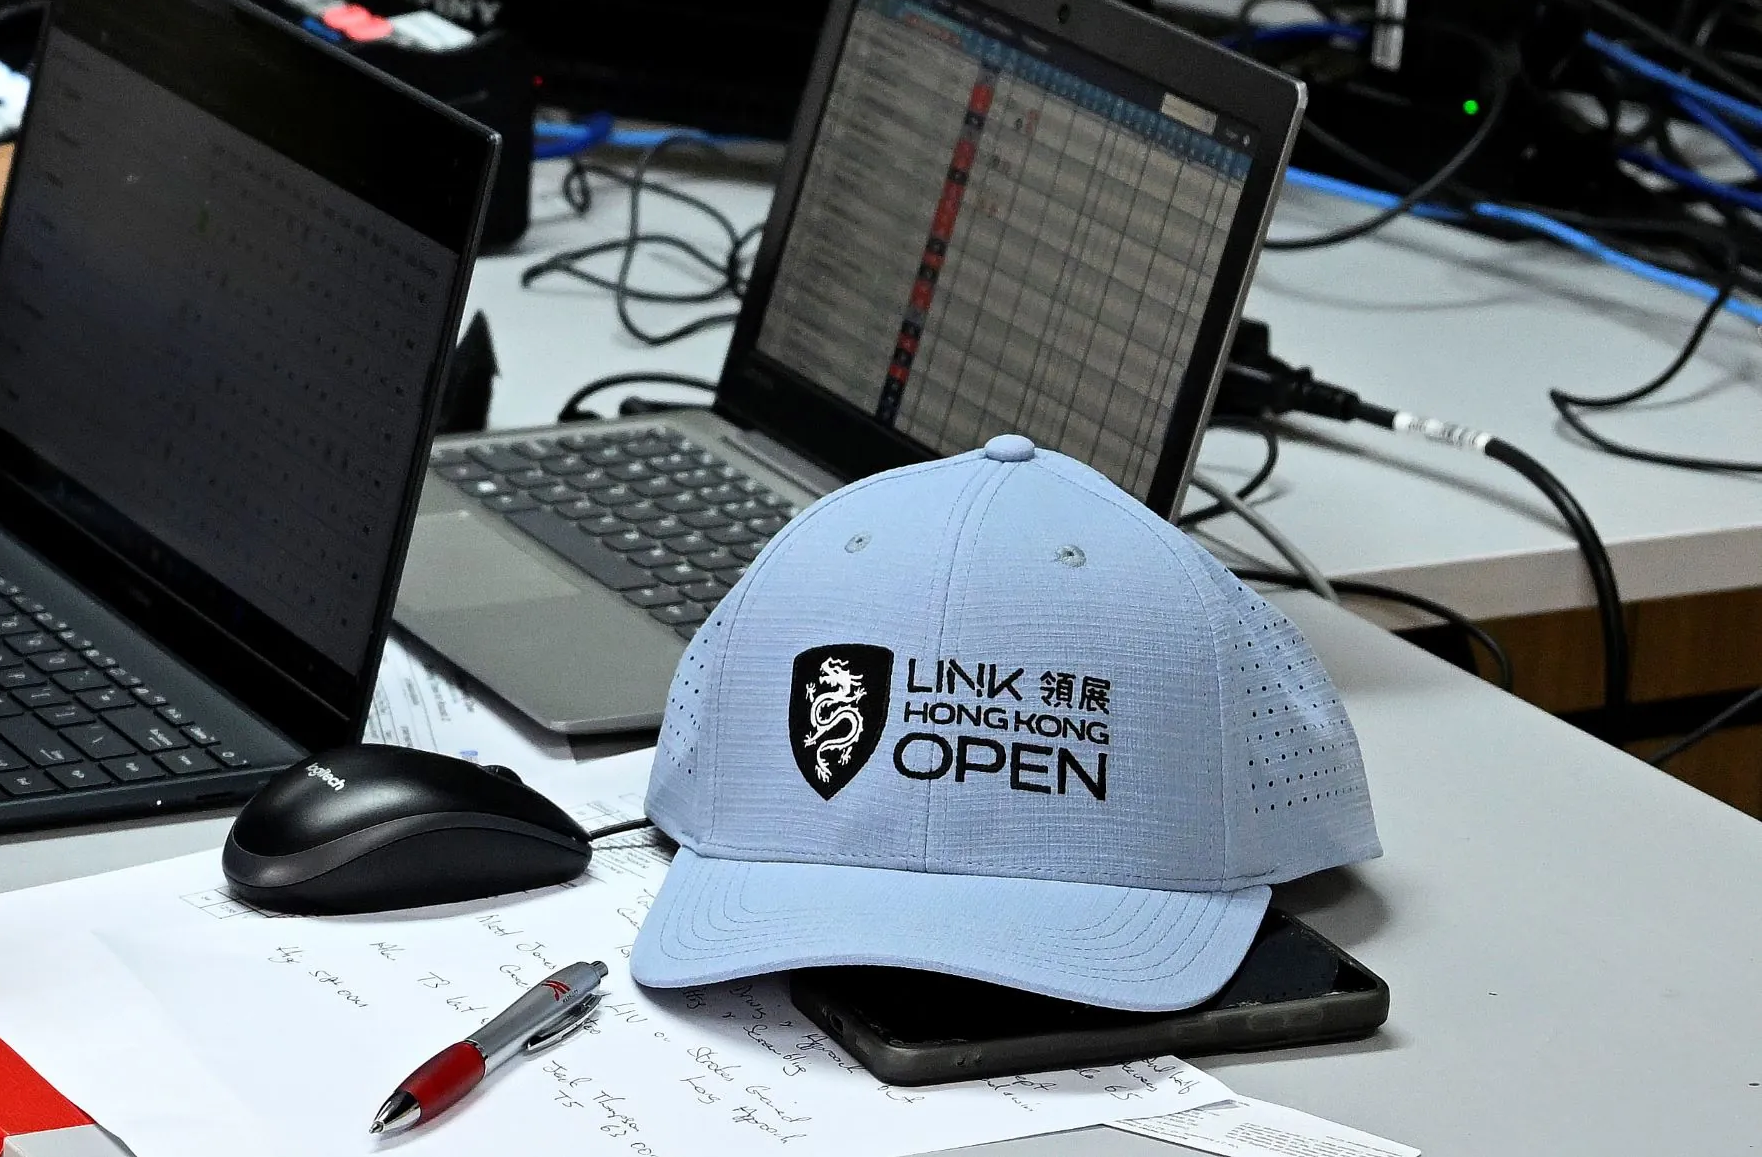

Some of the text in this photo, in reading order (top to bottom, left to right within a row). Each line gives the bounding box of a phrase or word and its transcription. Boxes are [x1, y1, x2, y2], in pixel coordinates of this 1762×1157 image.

[907, 658, 1025, 701] LINK
[1039, 670, 1111, 715] 領展
[893, 732, 1108, 802] OPEN
